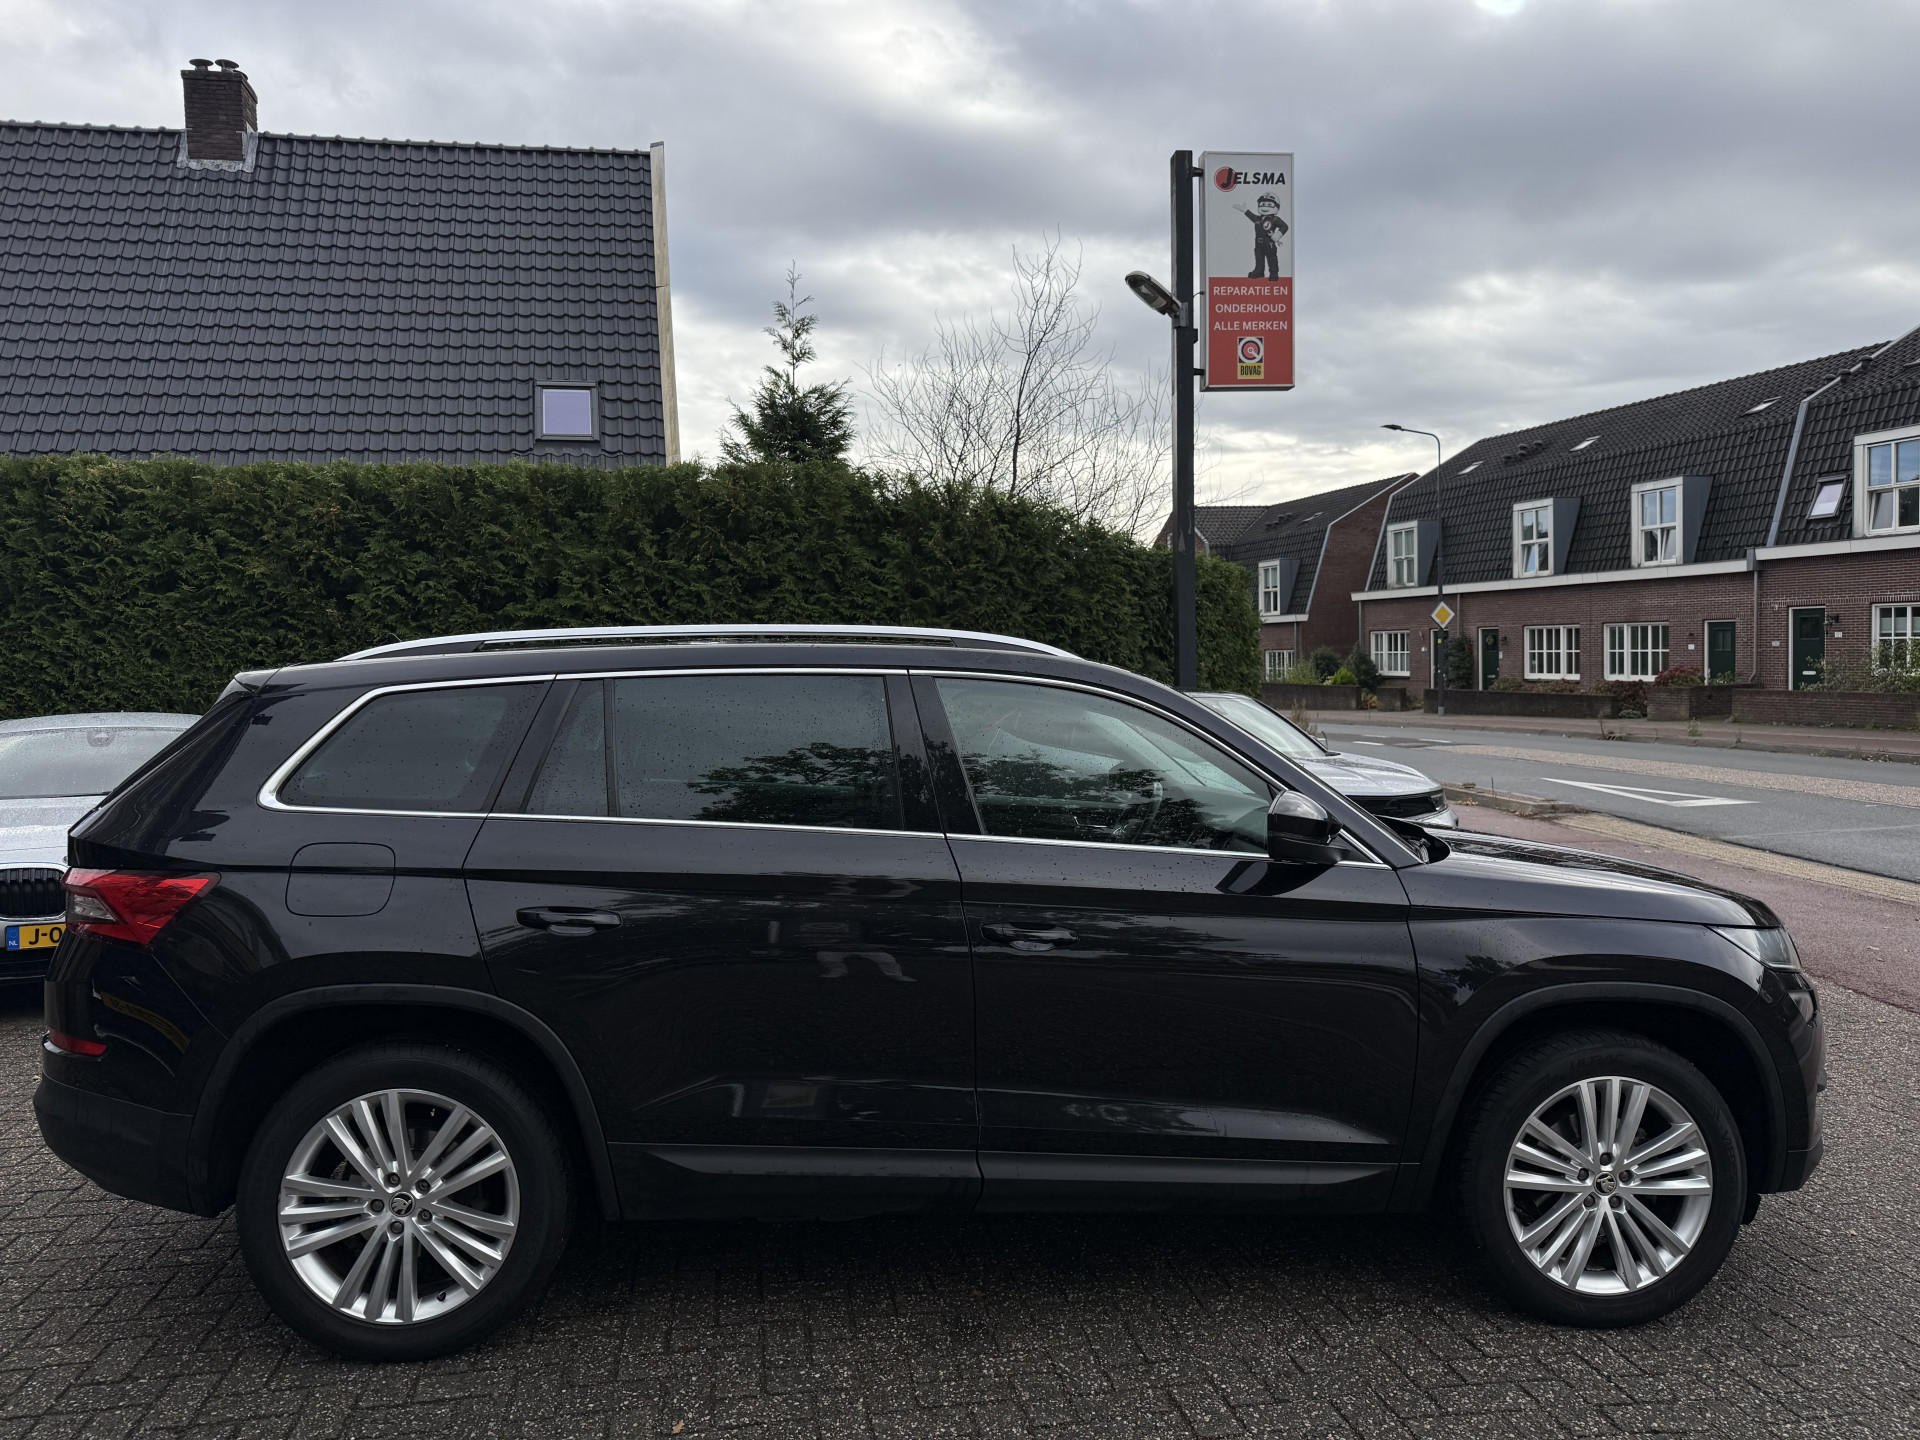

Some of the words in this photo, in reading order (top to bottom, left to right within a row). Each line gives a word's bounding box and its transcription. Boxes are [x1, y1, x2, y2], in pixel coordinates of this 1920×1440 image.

[1221, 167, 1286, 188] JELSMA
[1213, 286, 1271, 296] REPARATIE
[1273, 286, 1288, 296] EN
[1215, 303, 1286, 313] ONDERHOUD
[1213, 321, 1240, 331] ALLE
[1242, 321, 1288, 331] MERKEN
[1240, 365, 1262, 376] BOVAG
